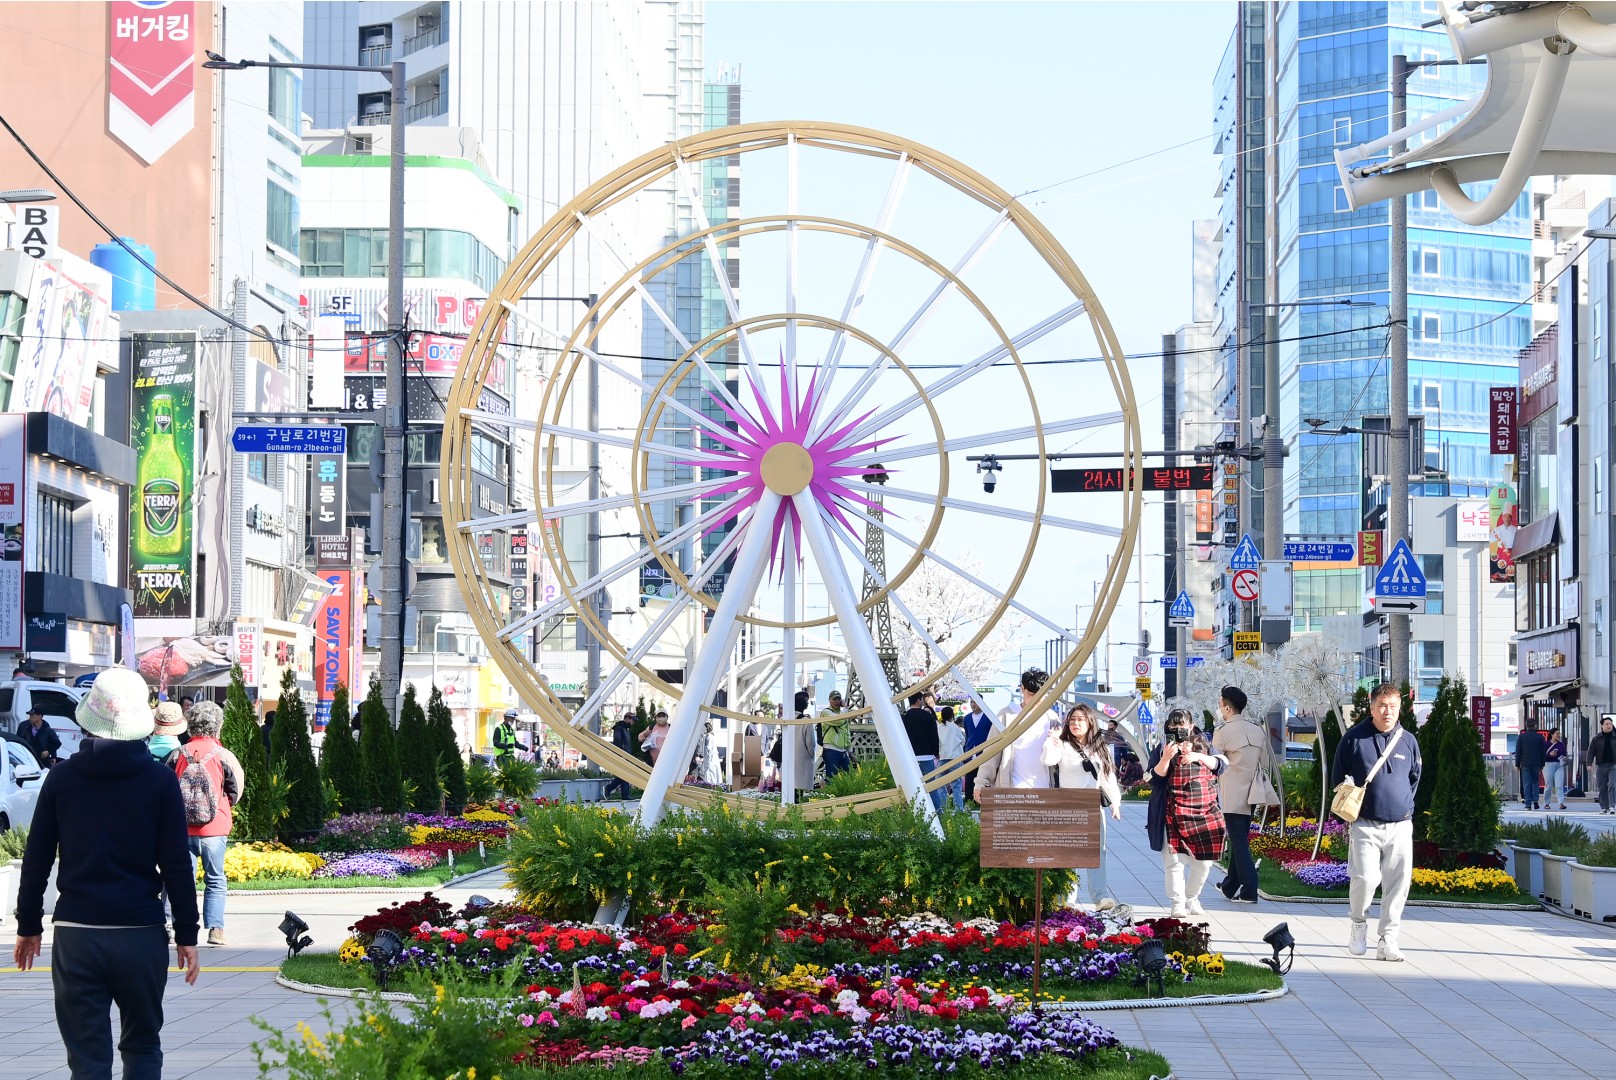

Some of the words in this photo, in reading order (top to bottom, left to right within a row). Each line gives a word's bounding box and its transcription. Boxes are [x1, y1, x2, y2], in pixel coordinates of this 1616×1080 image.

[116, 14, 190, 42] 버거킹
[331, 296, 352, 312] 5F
[173, 372, 193, 384] 100%
[1491, 390, 1515, 402] 밀양
[155, 414, 172, 423] TERRA
[1496, 402, 1511, 451] 돼지국밥
[237, 433, 246, 441] 39
[266, 428, 305, 442] 구남로
[306, 428, 343, 443] 21번길
[266, 443, 302, 452] Gunam-ro
[303, 443, 343, 453] 21beon-gil
[1153, 469, 1191, 489] 불법
[145, 495, 178, 508] TERRA
[320, 543, 348, 551] HOTEL
[511, 536, 527, 547] PC
[1307, 544, 1334, 554] 24번길
[1362, 532, 1376, 565] BAR
[137, 573, 183, 590] TERRA
[1382, 585, 1418, 594] 횡단보도
[1236, 642, 1258, 650] CCTV
[1138, 664, 1146, 673] 30
